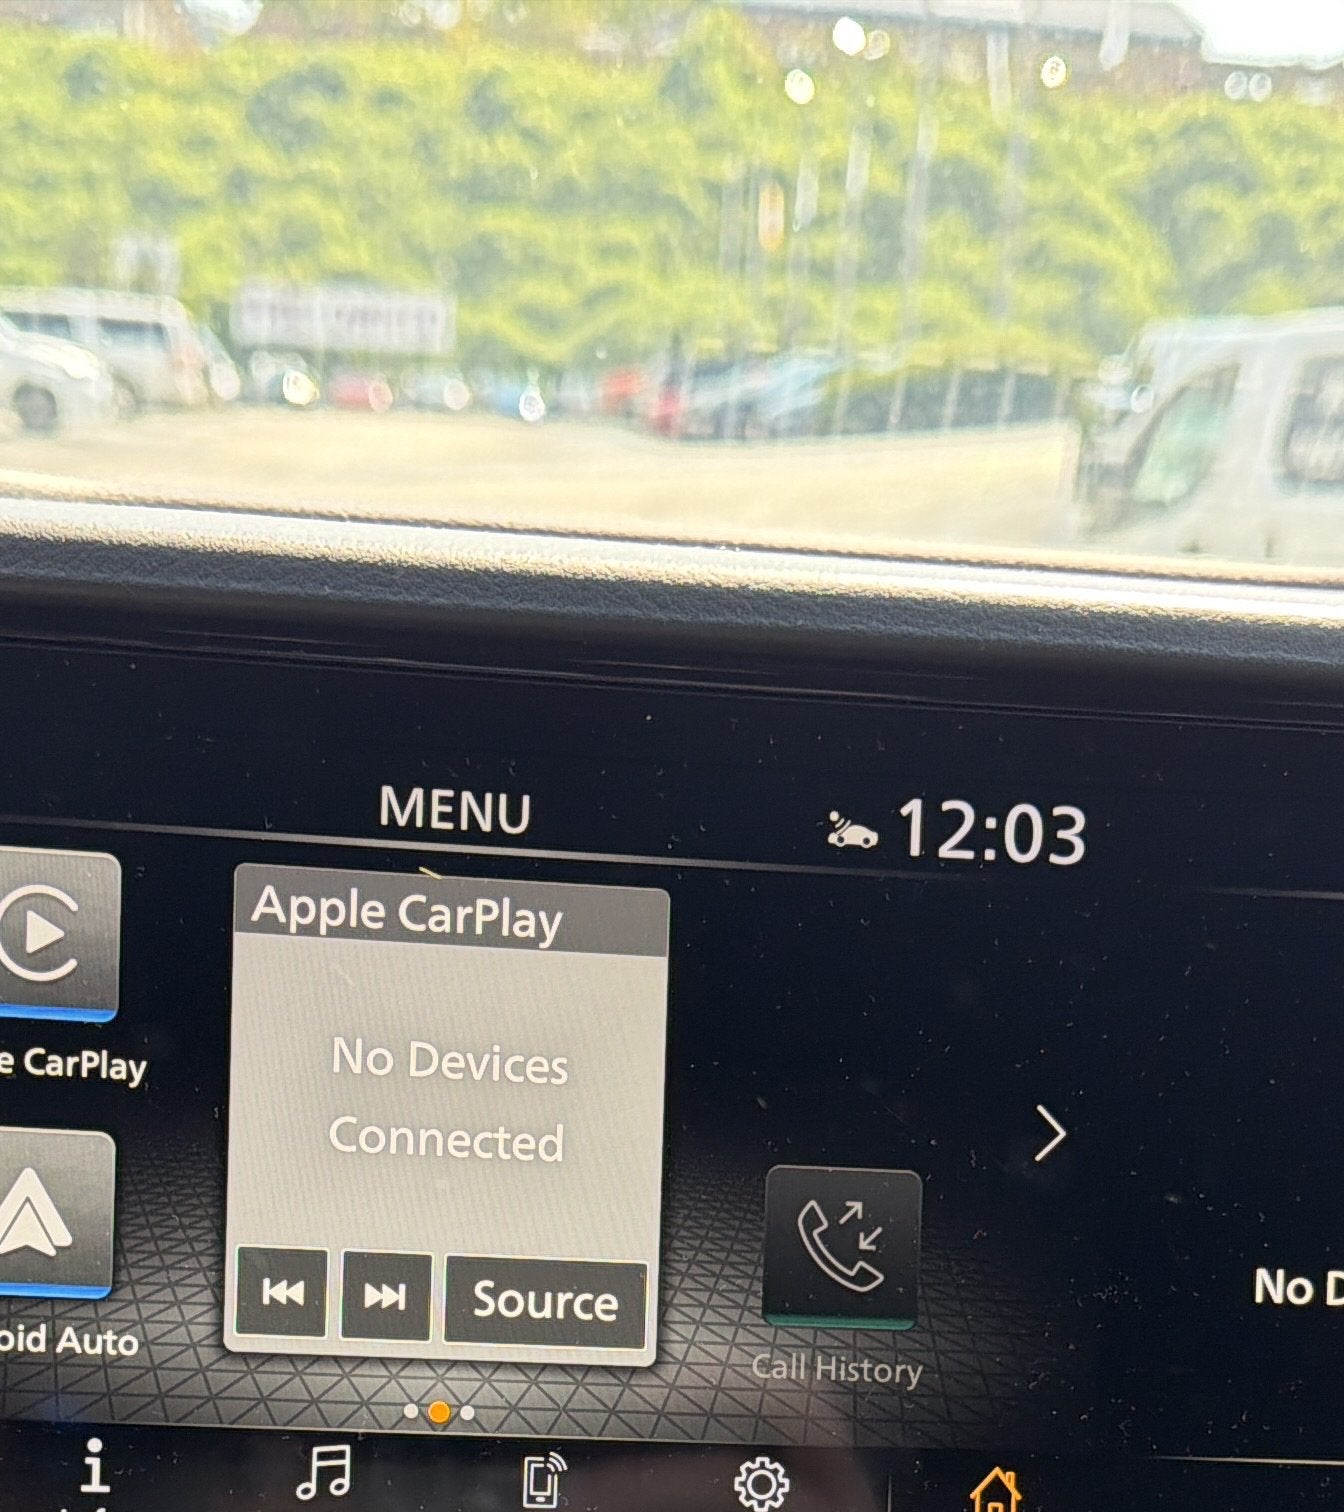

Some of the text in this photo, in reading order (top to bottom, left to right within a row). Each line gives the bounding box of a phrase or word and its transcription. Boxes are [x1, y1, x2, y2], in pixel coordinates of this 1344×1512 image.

[379, 784, 531, 835] MENU
[900, 798, 1087, 866] 12:03
[250, 884, 564, 949] Apple CarPlay
[23, 1047, 148, 1088] CarPlay
[331, 1036, 569, 1086] No Devices
[328, 1115, 564, 1163] Connected
[473, 1279, 620, 1323] Source
[1254, 1267, 1314, 1306] No
[55, 1326, 140, 1358] Auto
[752, 1353, 924, 1391] Call History
